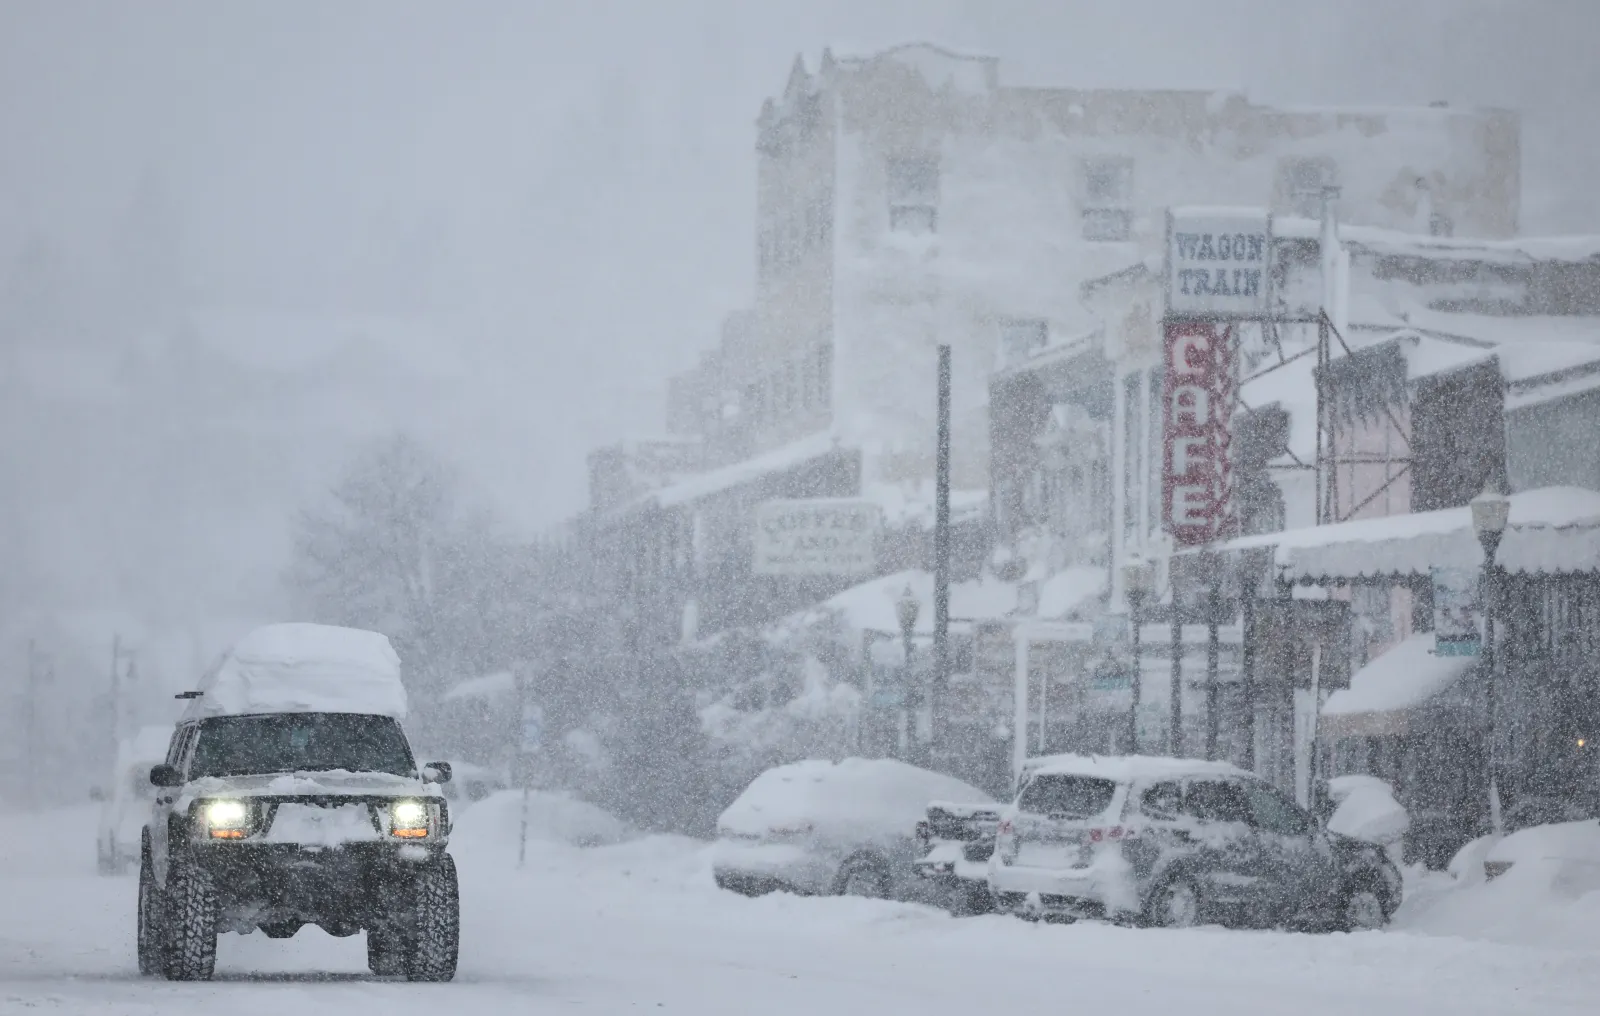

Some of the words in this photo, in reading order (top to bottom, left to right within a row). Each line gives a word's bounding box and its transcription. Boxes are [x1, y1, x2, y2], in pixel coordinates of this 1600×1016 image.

[1176, 232, 1265, 260] WAGON
[1179, 268, 1261, 296] TRAIN
[1172, 335, 1209, 526] CAFE
